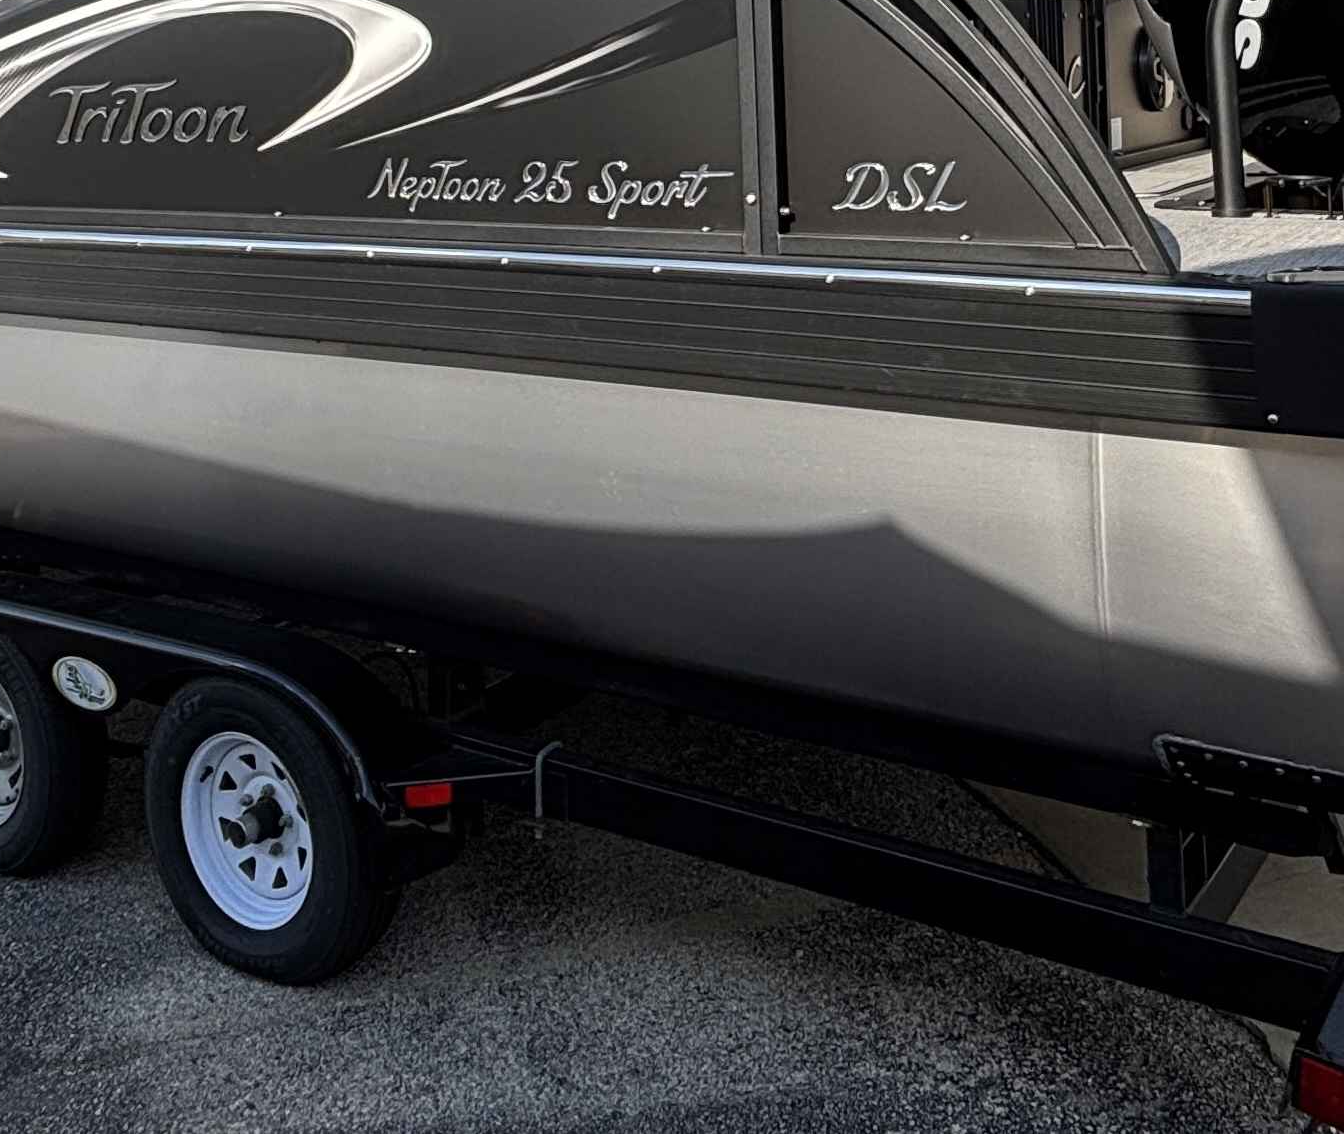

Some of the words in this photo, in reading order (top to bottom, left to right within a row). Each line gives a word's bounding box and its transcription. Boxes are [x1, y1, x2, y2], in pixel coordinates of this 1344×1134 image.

[49, 79, 248, 144] TriToon
[367, 157, 505, 212] NepToon
[514, 160, 580, 203] 25
[588, 160, 735, 219] Sport
[832, 161, 968, 212] DSL
